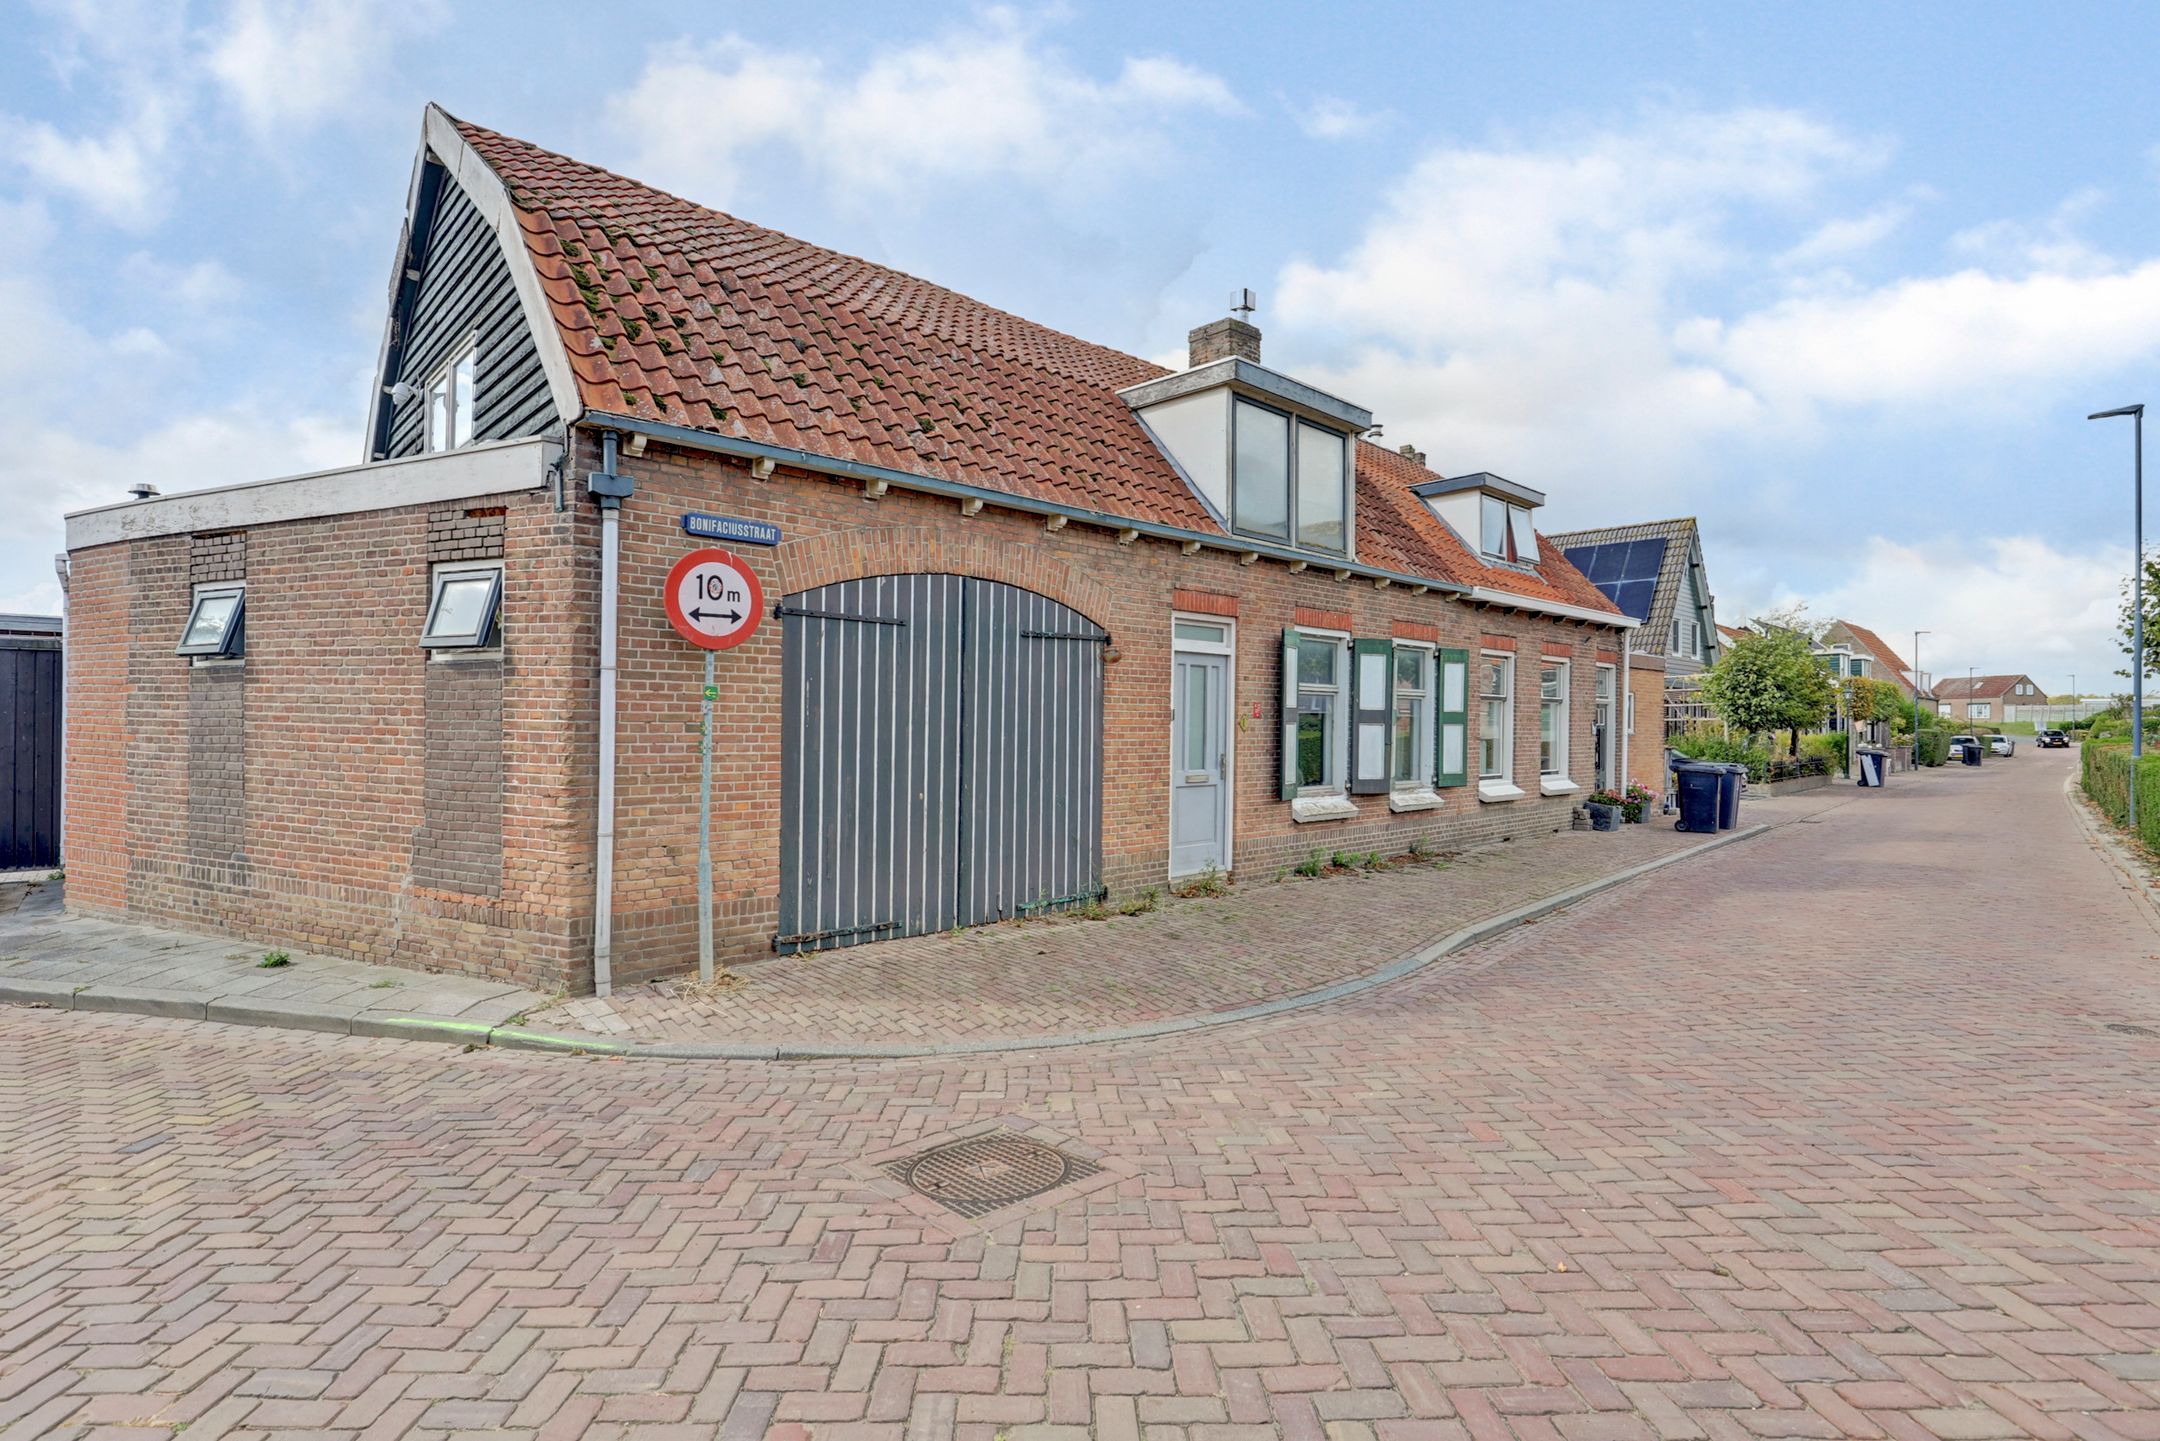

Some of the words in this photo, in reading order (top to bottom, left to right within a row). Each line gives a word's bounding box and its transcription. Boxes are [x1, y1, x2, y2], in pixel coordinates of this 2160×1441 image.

[690, 517, 776, 541] BONIFACIUSSTRAAT
[696, 574, 723, 601] 10
[727, 590, 741, 602] m
